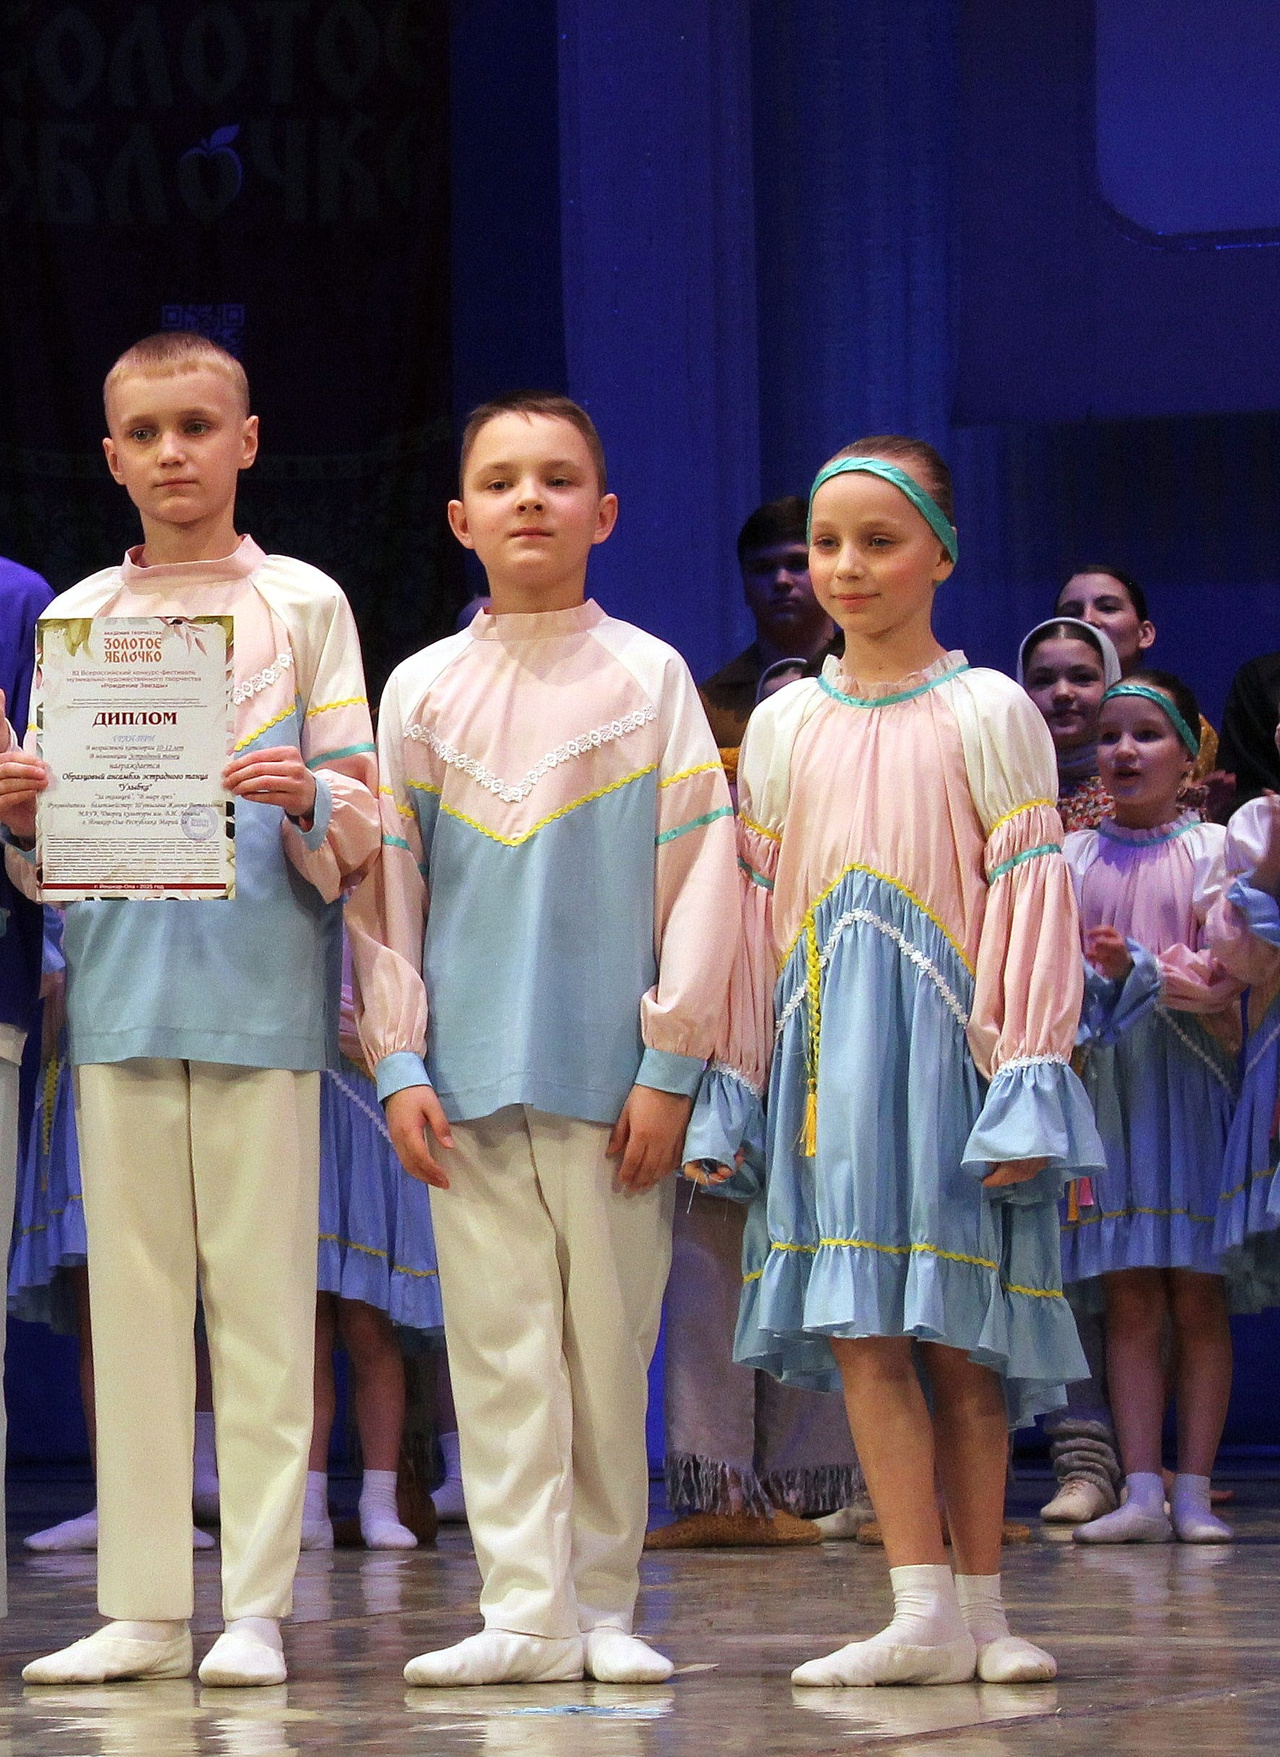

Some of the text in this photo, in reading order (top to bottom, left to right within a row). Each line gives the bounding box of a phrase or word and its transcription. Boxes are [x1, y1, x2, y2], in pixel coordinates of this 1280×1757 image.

[104, 638, 162, 650] ЗОЛОТОЕ
[104, 650, 162, 663] ЯБЛОЧКО
[92, 712, 177, 727] ДИПЛОМ
[109, 762, 161, 771] награждается
[62, 772, 105, 782] Образцовый
[106, 772, 141, 780] ансамбль
[143, 772, 184, 782] эстрадного
